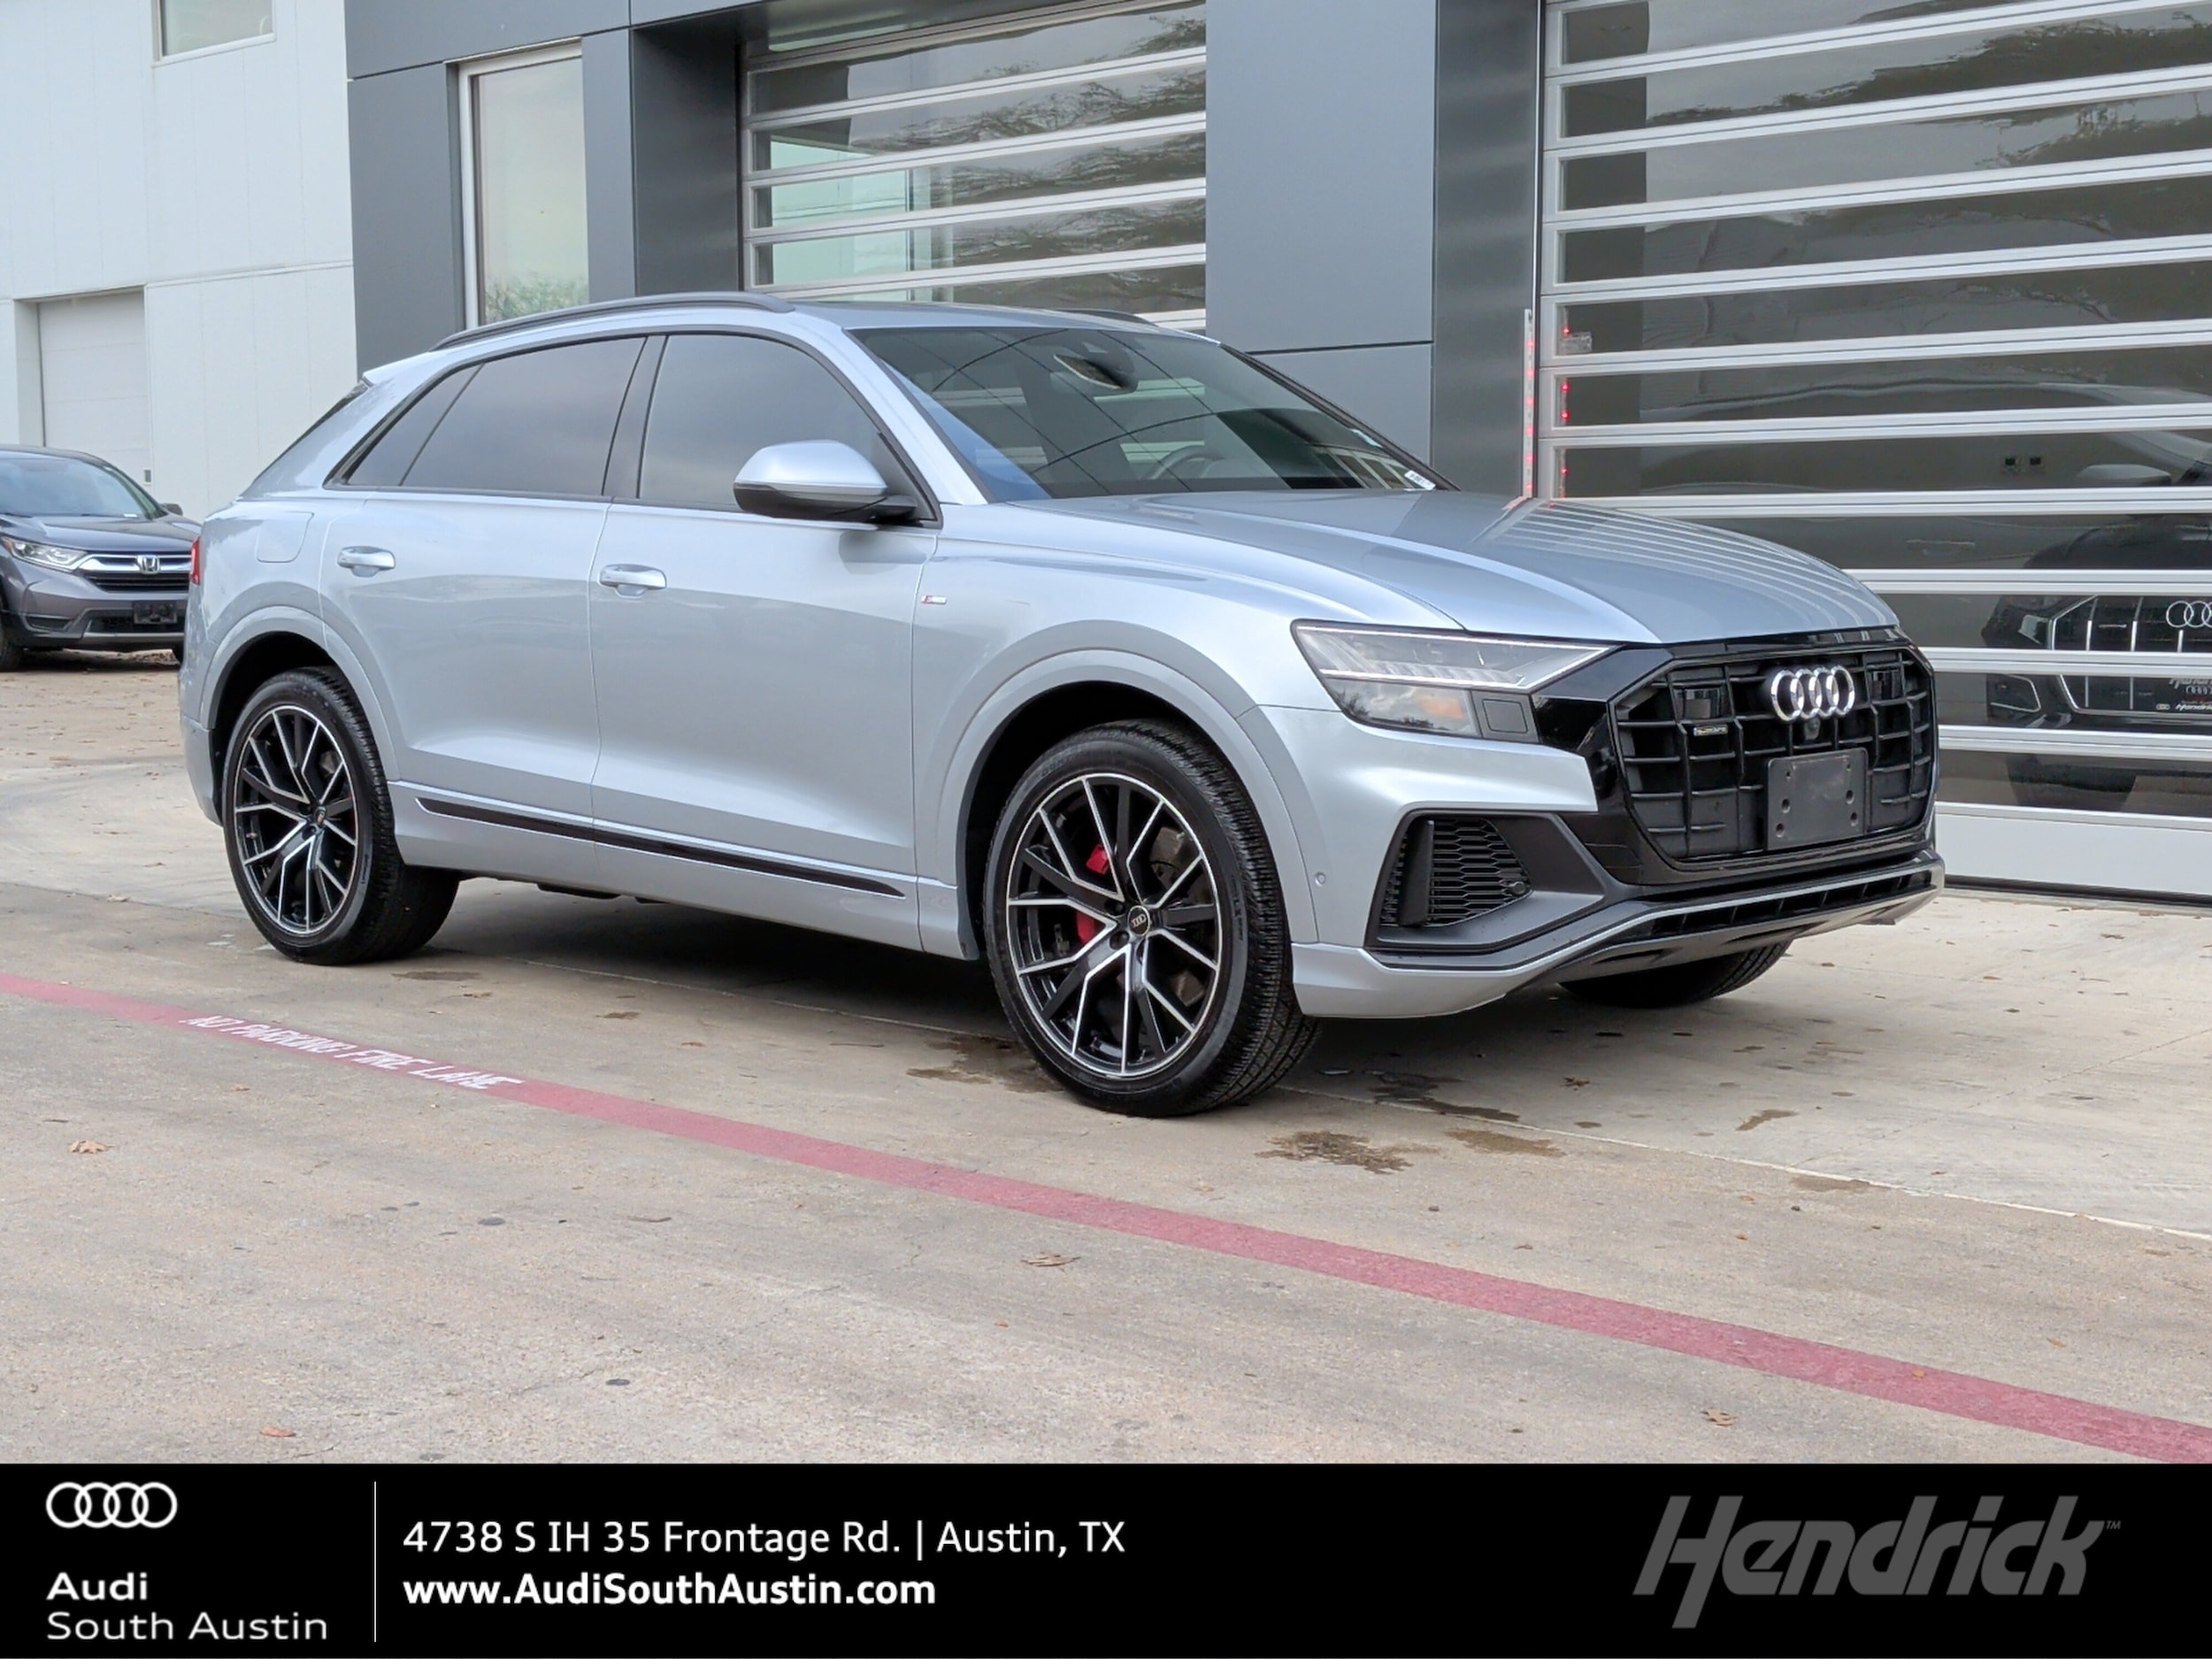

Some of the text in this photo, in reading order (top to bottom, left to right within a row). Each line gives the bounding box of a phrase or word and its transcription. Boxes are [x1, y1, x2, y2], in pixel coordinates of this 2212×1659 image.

[219, 1024, 358, 1054] PARKING
[334, 1049, 436, 1071] FIRE
[408, 1065, 526, 1090] LANE
